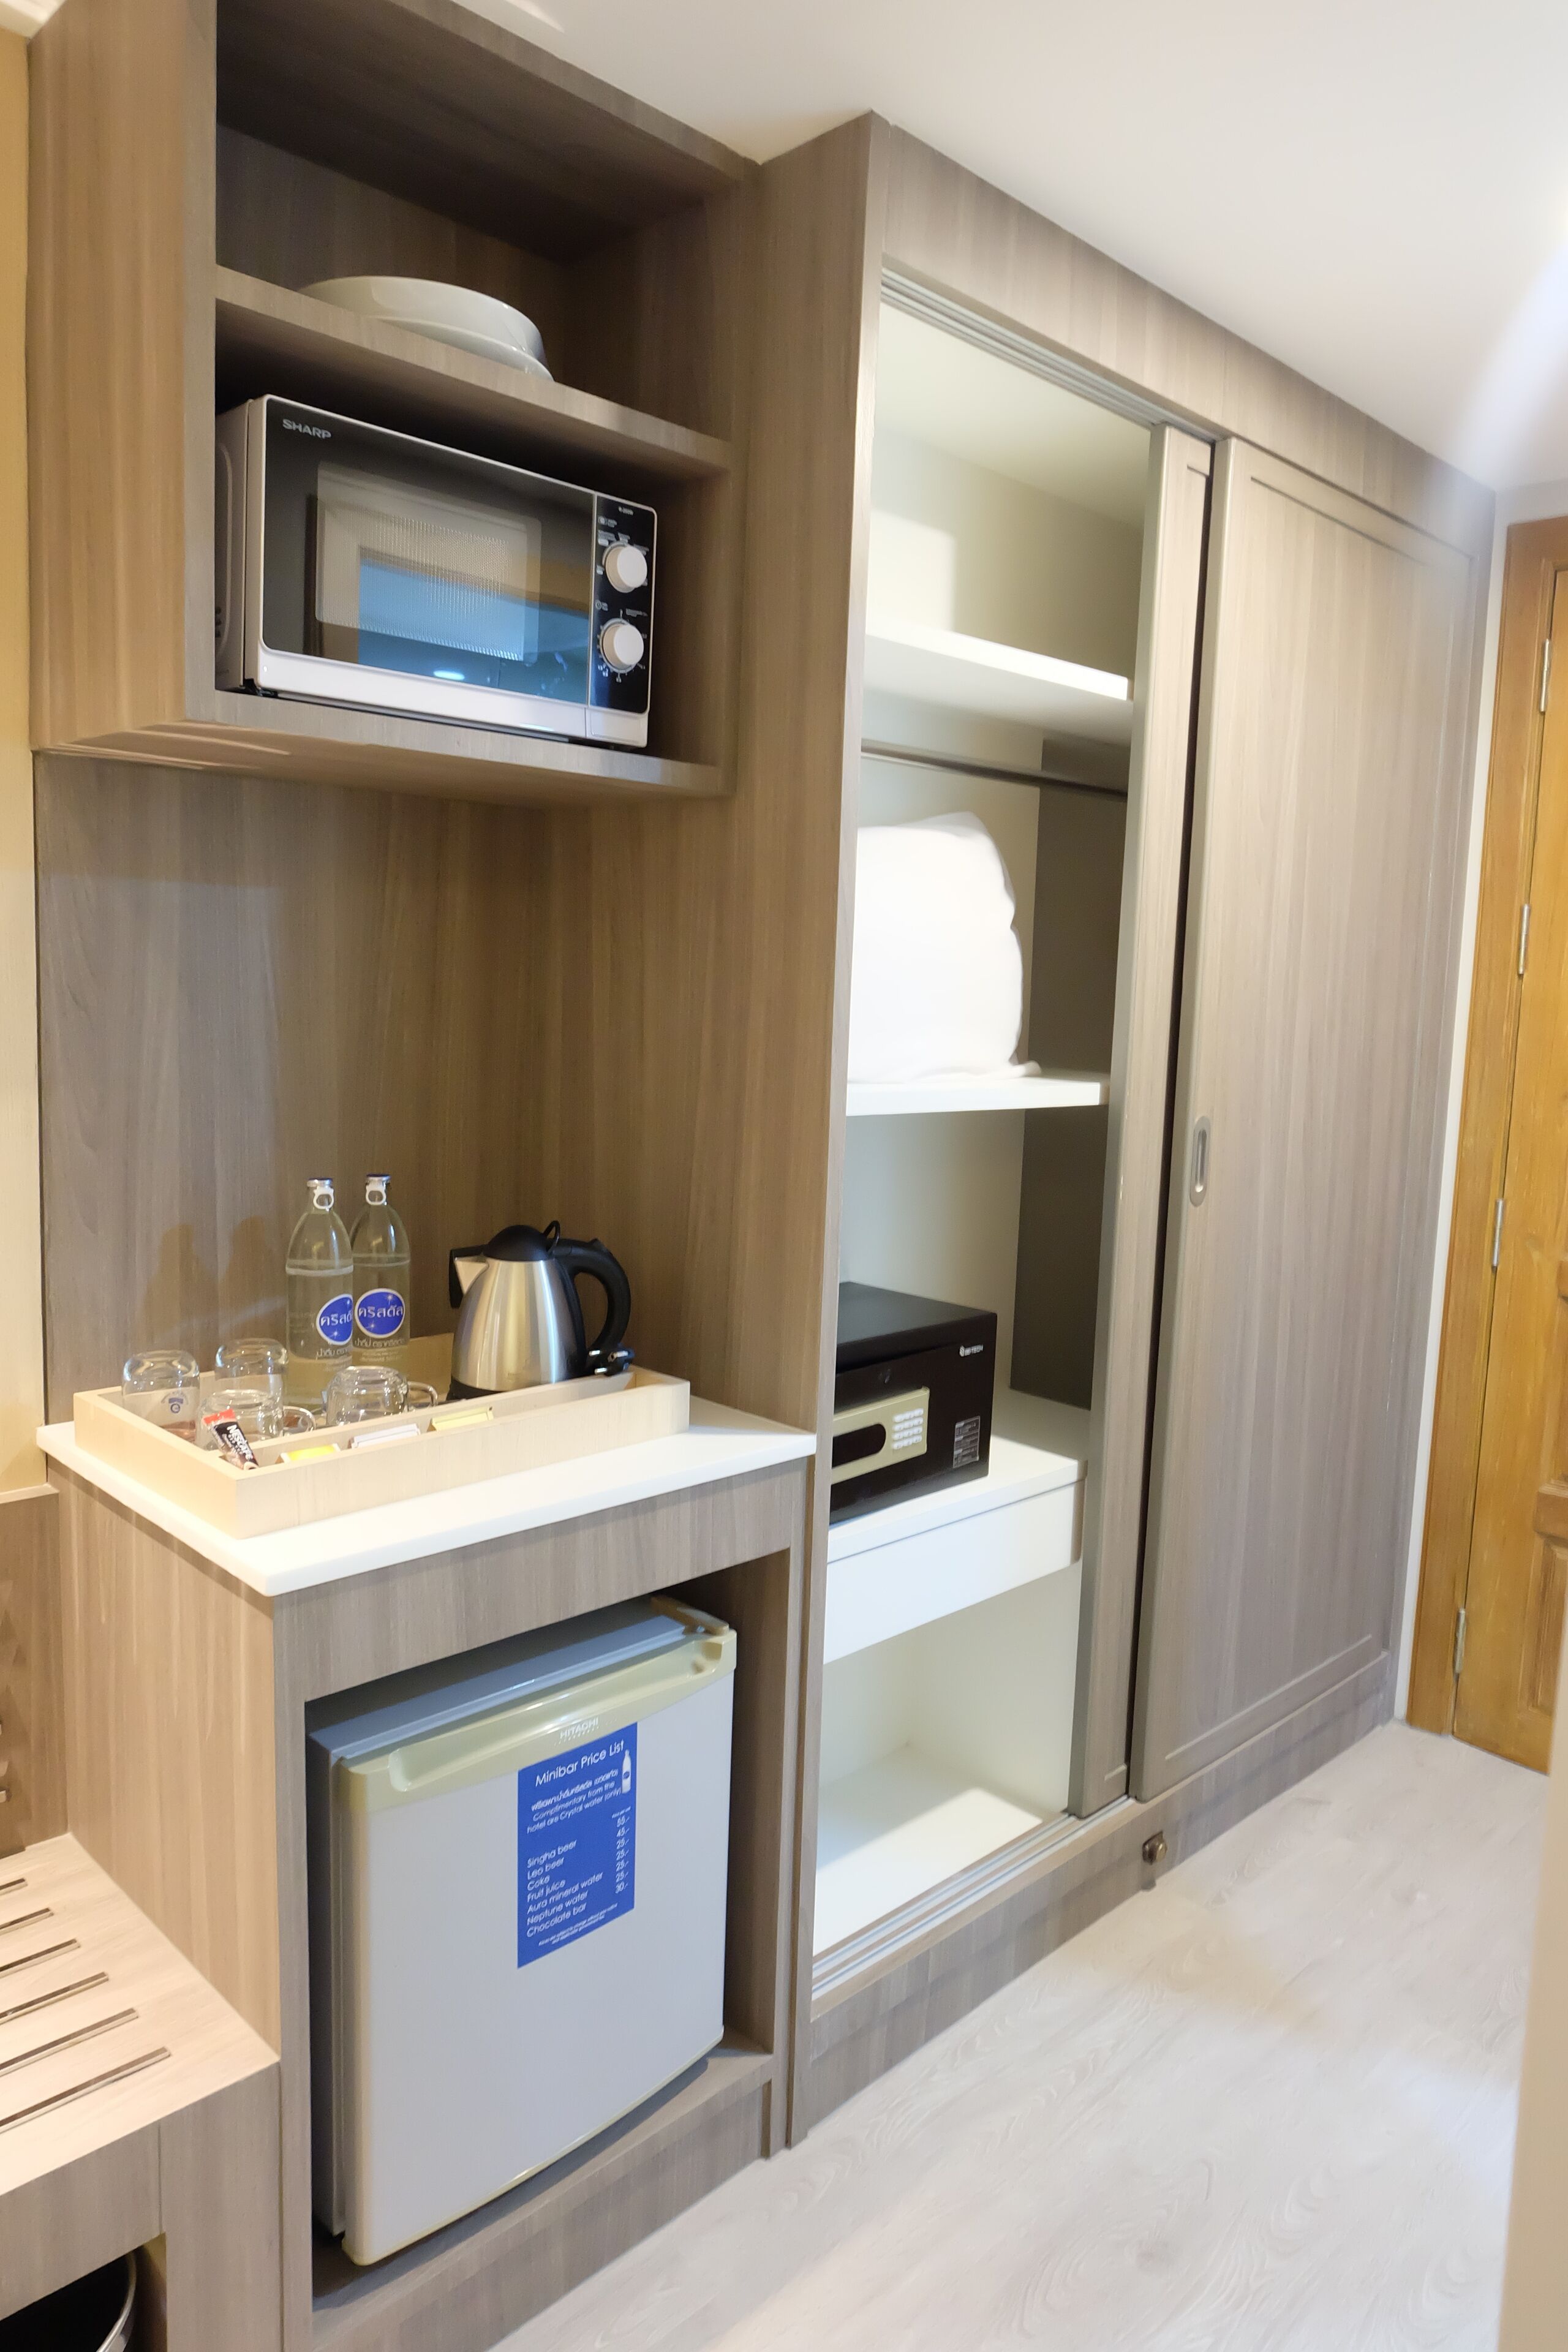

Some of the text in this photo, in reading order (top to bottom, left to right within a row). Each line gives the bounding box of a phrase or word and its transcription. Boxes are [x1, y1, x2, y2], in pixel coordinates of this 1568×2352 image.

[282, 418, 331, 439] SHARP
[358, 1304, 403, 1318] คริสตัล
[560, 1717, 599, 1740] HITACHI
[535, 1739, 624, 1787] Minibar Price List
[527, 1819, 546, 1834] hotel
[547, 1815, 559, 1826] are
[560, 1804, 583, 1821] Crystal
[584, 1796, 603, 1809] water
[533, 1781, 615, 1822] Complimentary from the
[527, 1839, 577, 1868] Singha beer
[527, 1856, 564, 1880] Leo beer
[527, 1875, 550, 1891] Coke
[527, 1879, 565, 1903] Fruit juice
[527, 1872, 603, 1915] Aura mineral water
[527, 1903, 564, 1926] Neptune
[565, 1890, 588, 1907] water
[527, 1910, 571, 1937] Chocolate
[573, 1902, 587, 1915] bar
